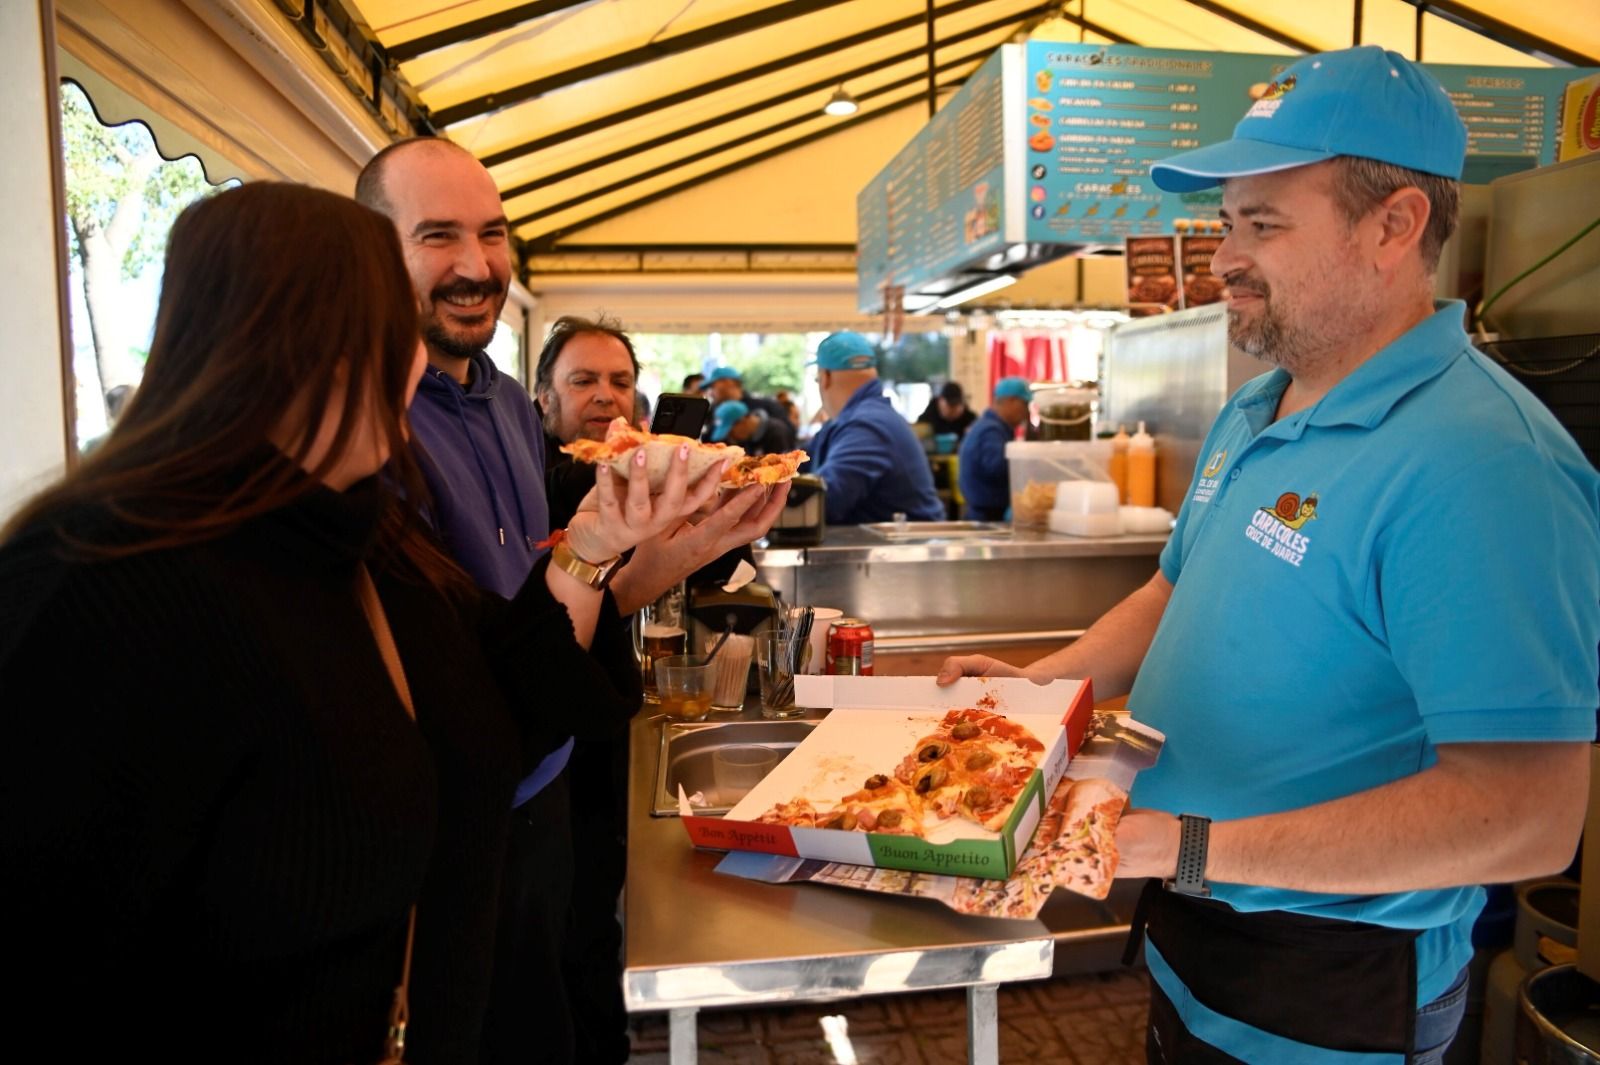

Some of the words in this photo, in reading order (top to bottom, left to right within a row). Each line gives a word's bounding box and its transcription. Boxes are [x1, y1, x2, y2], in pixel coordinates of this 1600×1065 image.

[1245, 525, 1264, 544] CRUZ
[1260, 535, 1274, 550] DE
[1252, 509, 1310, 554] CARACOLES
[698, 826, 726, 839] Bon
[880, 845, 919, 860] Buon
[923, 848, 990, 867] Appetito
